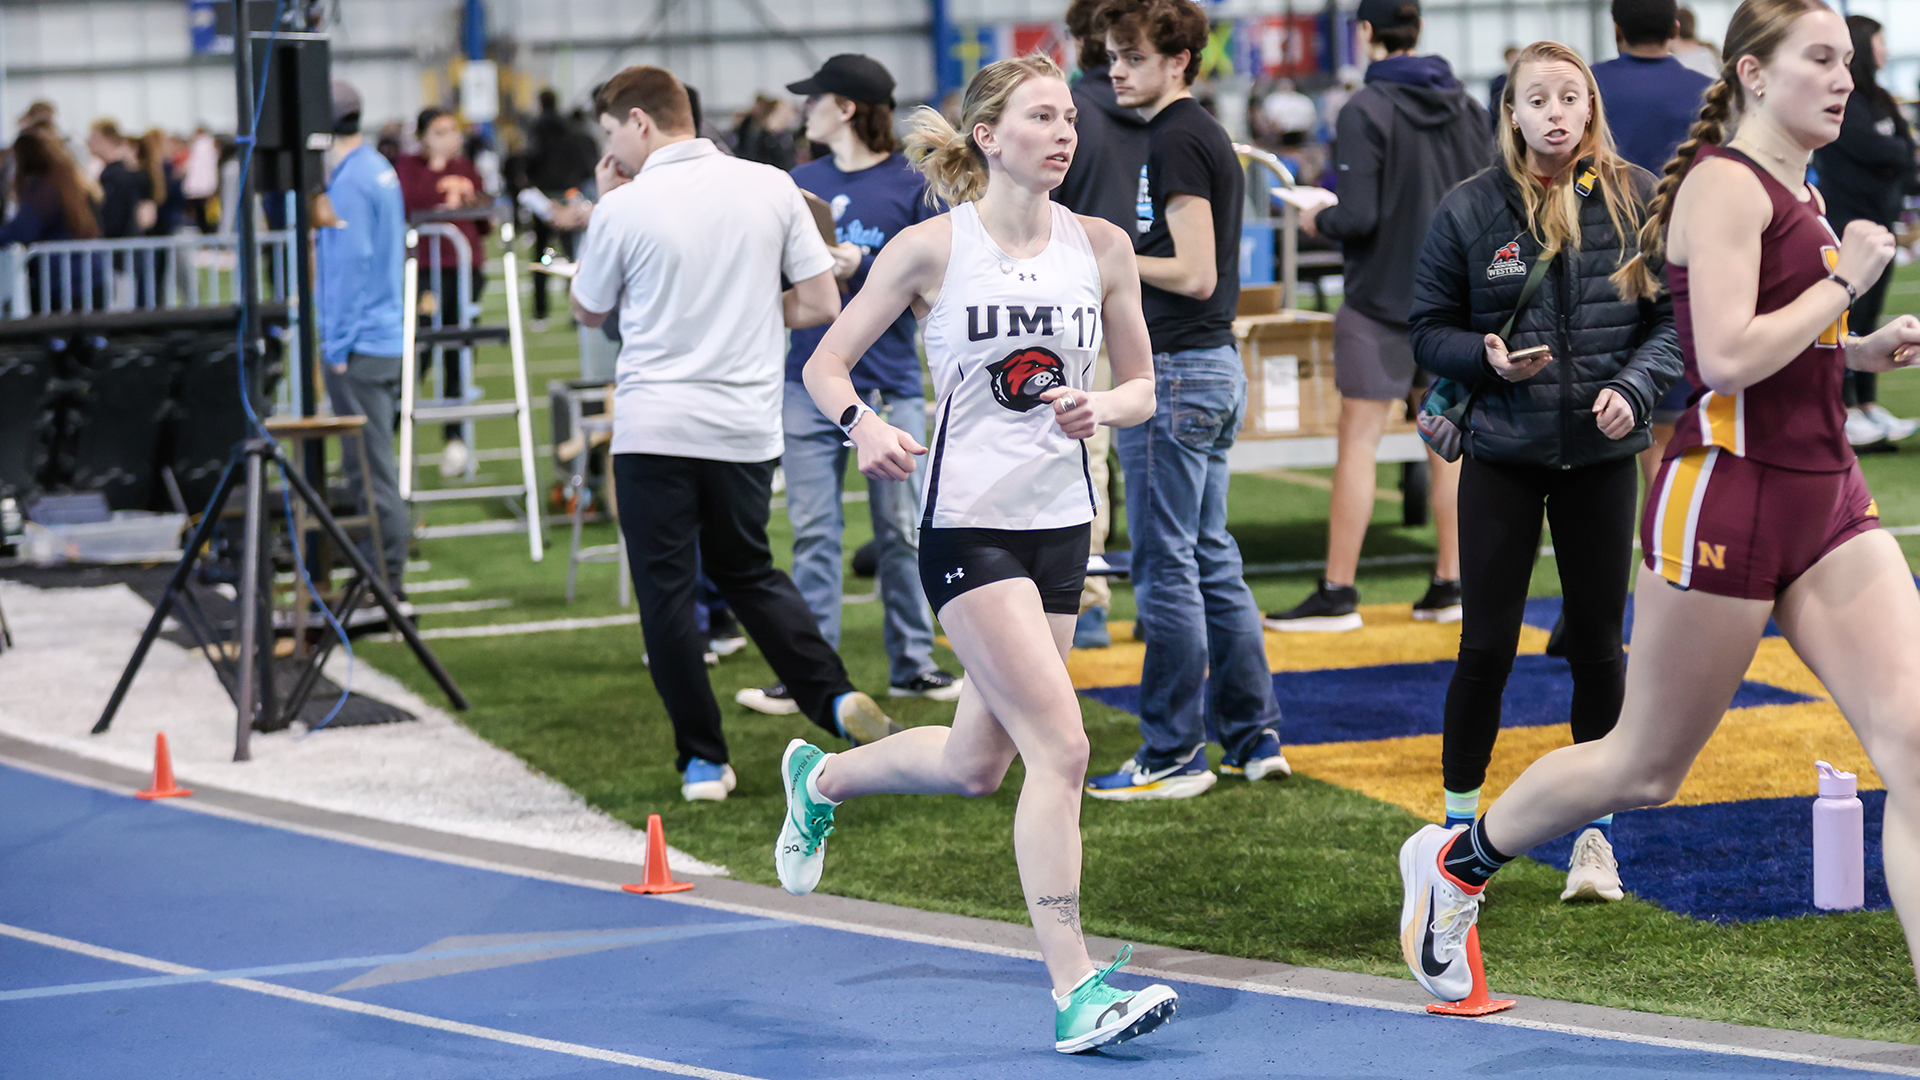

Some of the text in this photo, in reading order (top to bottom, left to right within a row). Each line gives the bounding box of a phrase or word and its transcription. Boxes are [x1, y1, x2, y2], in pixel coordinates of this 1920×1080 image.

[1488, 265, 1525, 277] WESTERN
[966, 305, 1064, 342] UM
[1071, 306, 1098, 349] 17
[1698, 540, 1727, 569] N
[791, 758, 809, 796] RUNNIN
